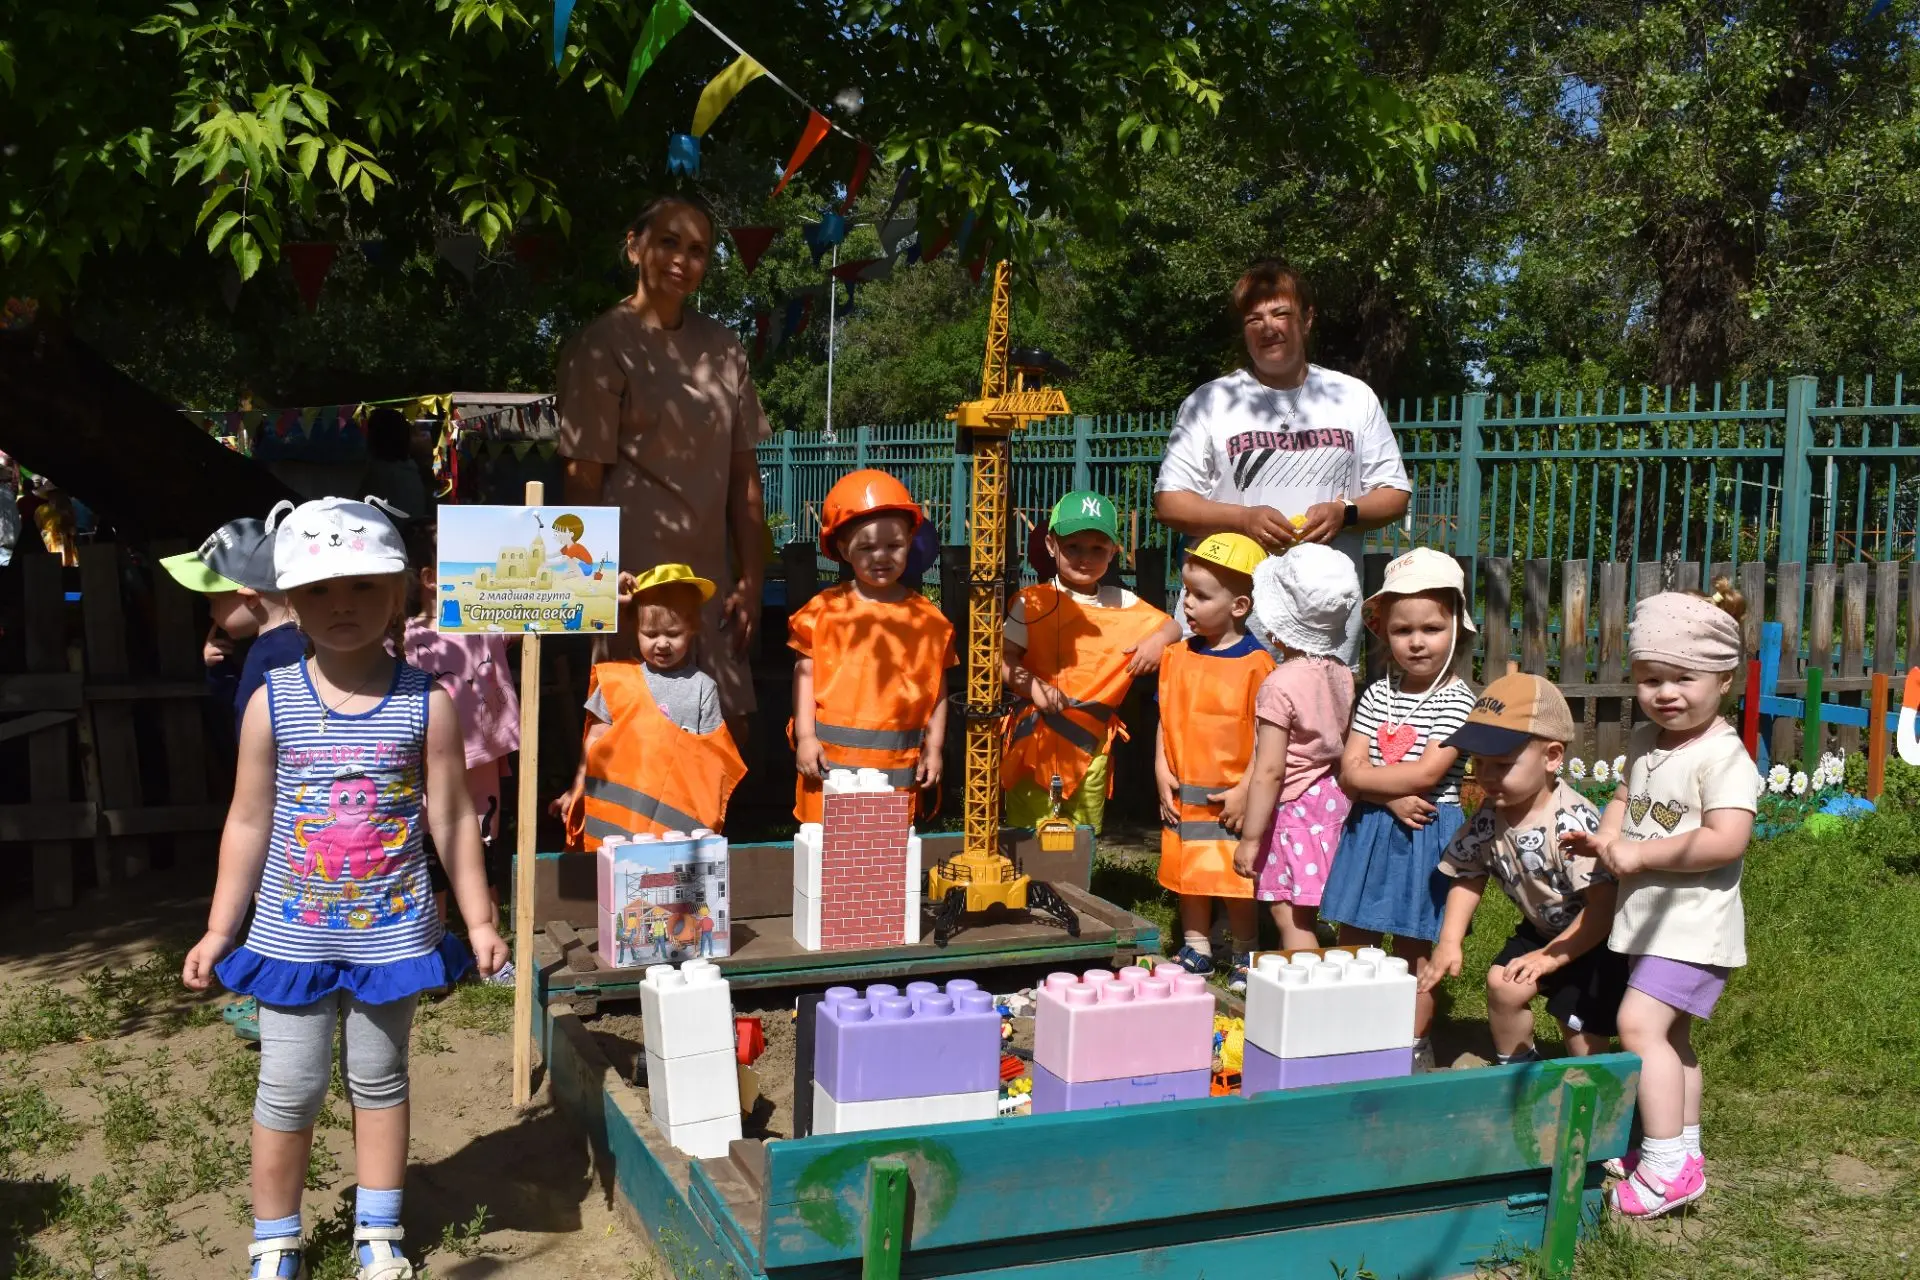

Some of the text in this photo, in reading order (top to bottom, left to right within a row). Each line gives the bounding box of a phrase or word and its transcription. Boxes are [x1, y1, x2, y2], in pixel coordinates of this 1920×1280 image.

[479, 590, 571, 602] 2 младшая группа
[464, 603, 584, 624] "Стройка века"
